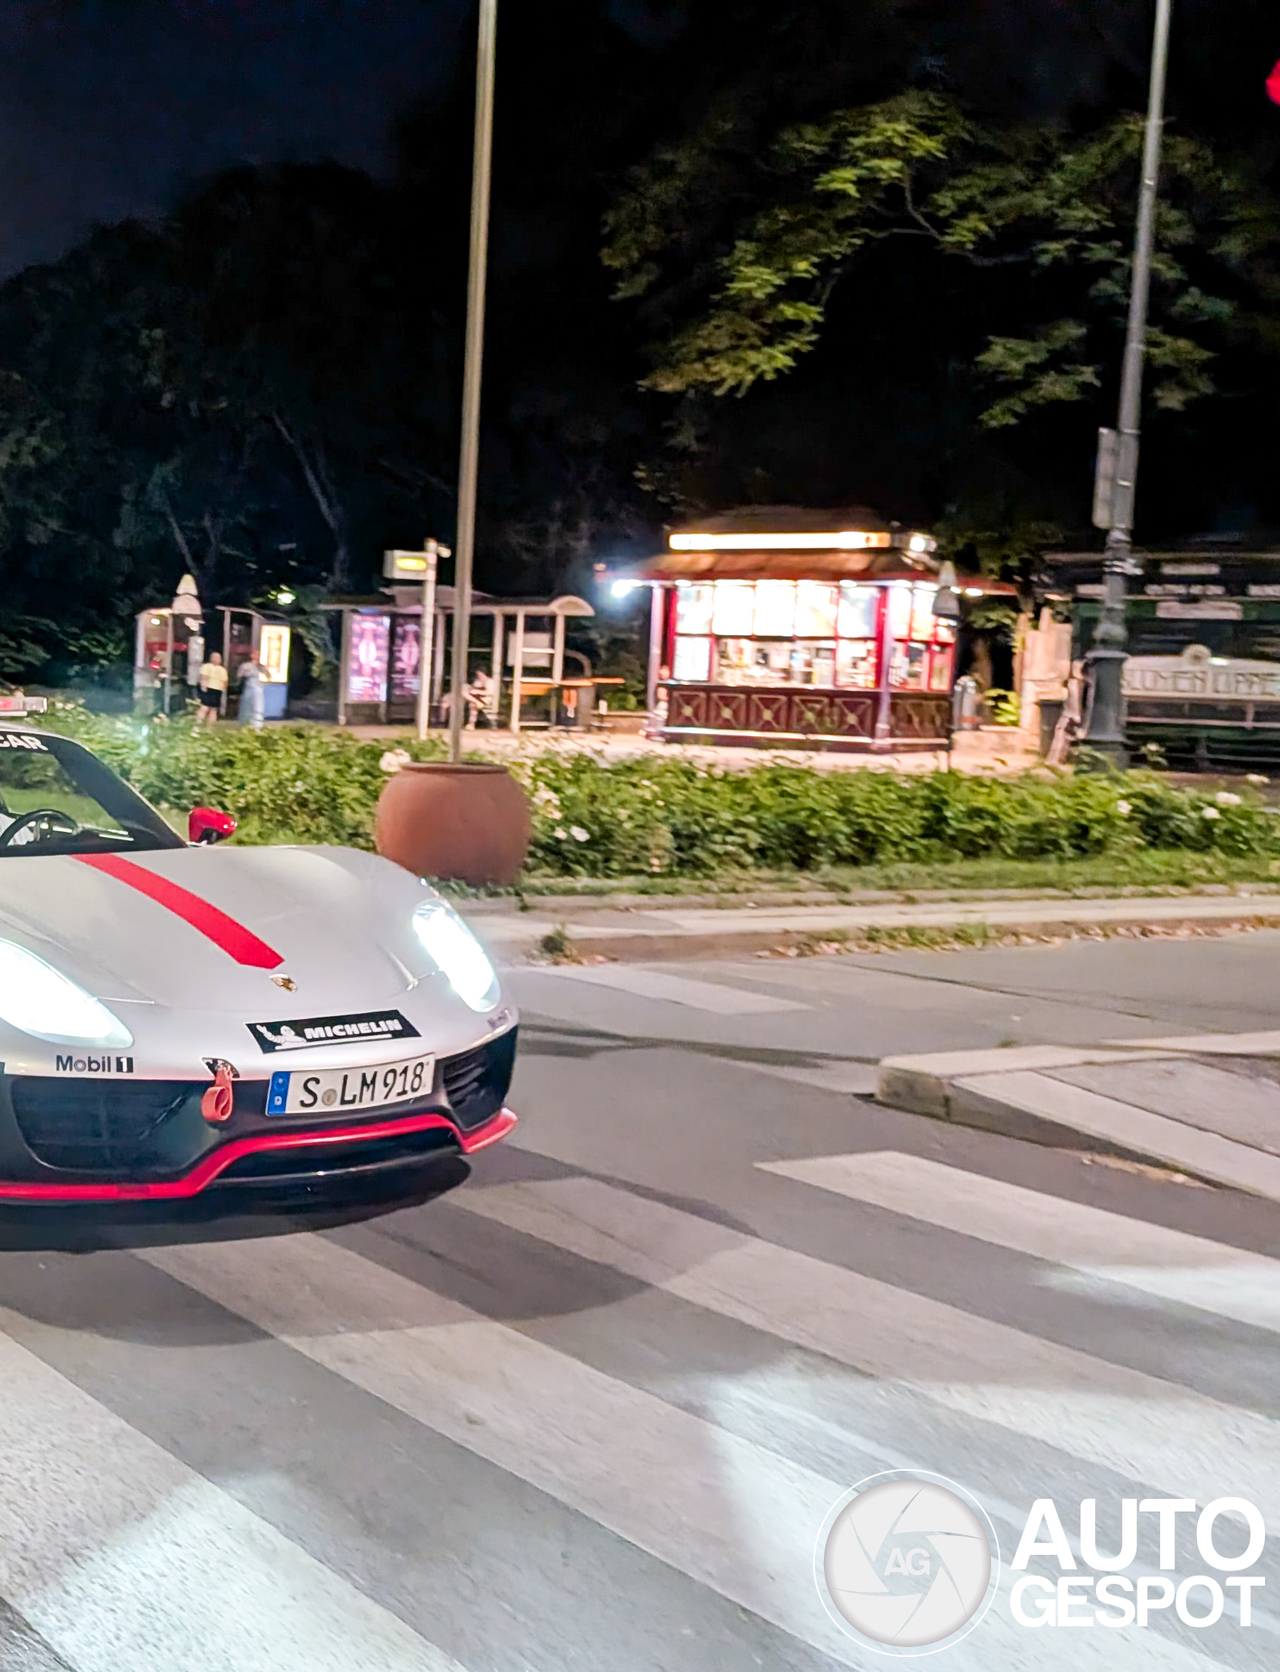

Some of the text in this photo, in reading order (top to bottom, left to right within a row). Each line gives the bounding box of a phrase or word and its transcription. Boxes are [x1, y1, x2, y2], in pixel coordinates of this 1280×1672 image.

[304, 1019, 403, 1039] MICHELIN
[56, 1055, 111, 1072] Mobil
[299, 1061, 425, 1108] S LM 918
